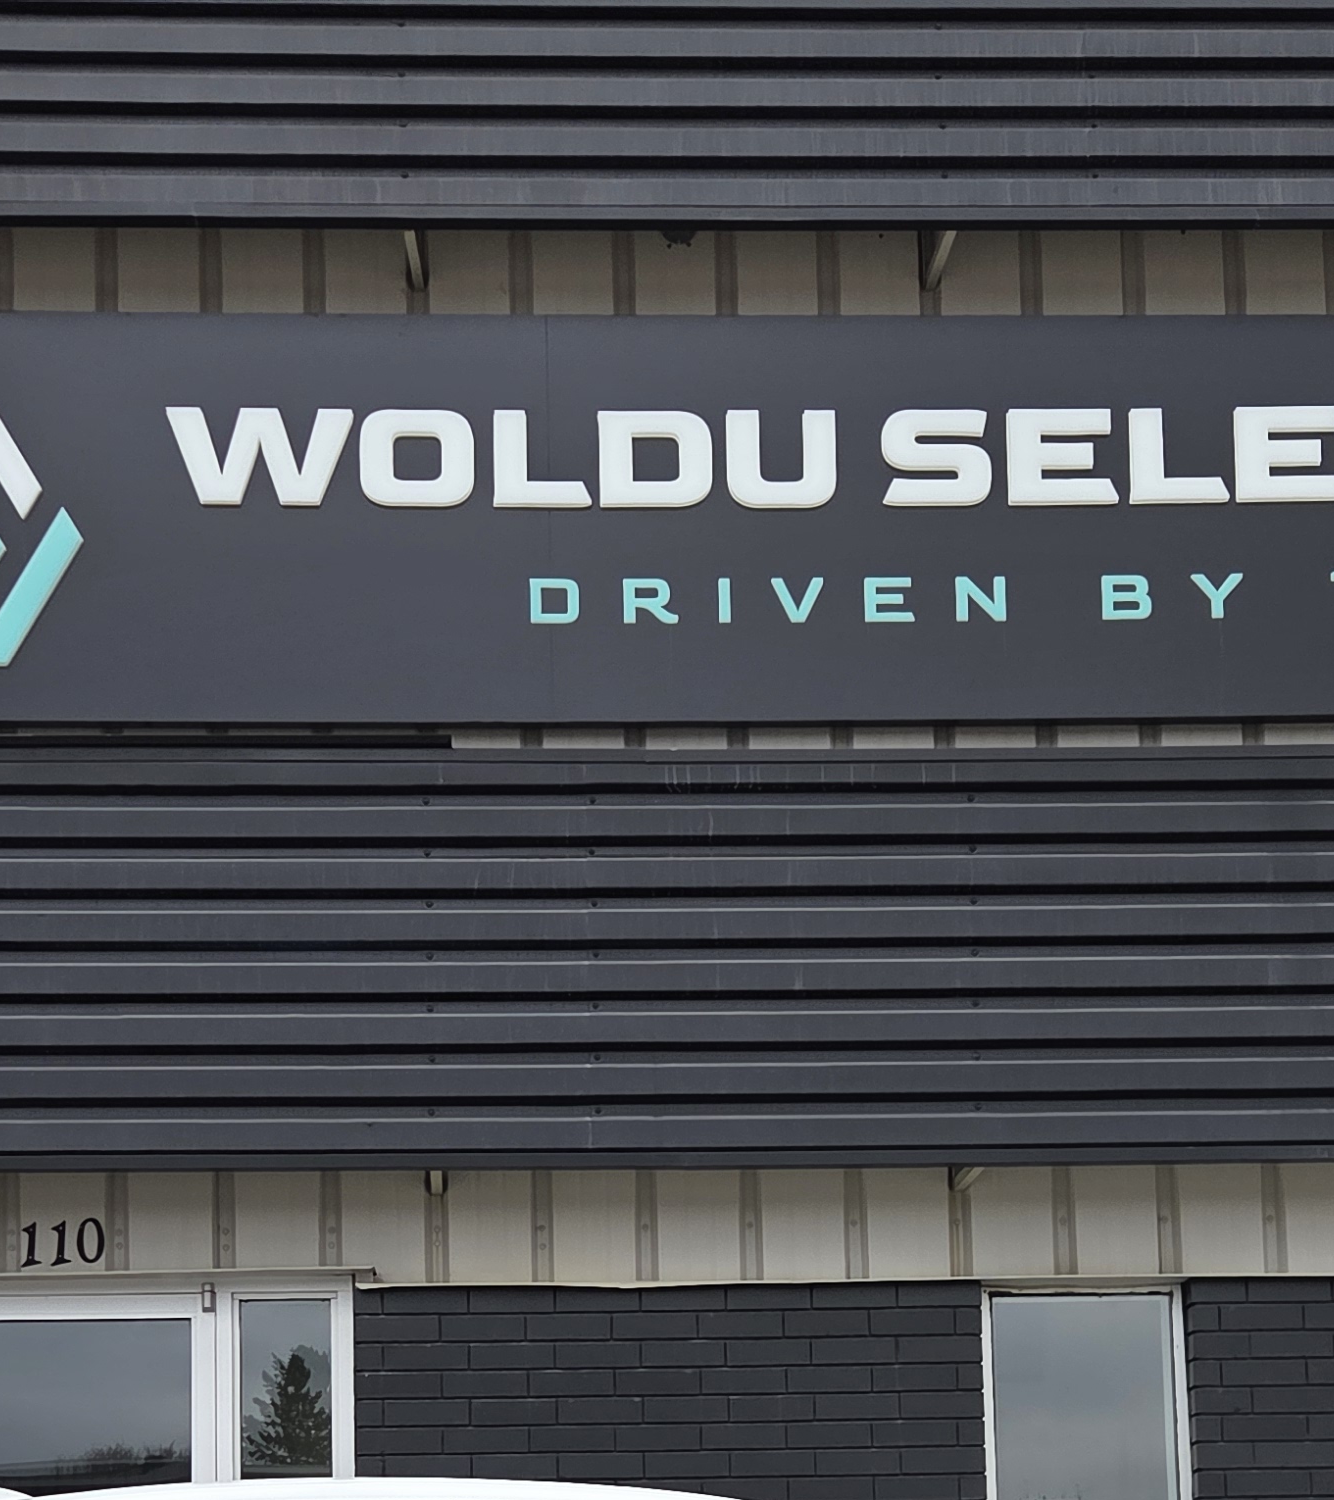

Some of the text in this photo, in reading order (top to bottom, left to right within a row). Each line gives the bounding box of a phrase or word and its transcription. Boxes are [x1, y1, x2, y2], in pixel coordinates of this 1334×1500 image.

[164, 406, 837, 509] WOLDU
[529, 575, 1007, 623] DRIVEN
[1102, 572, 1242, 619] BY
